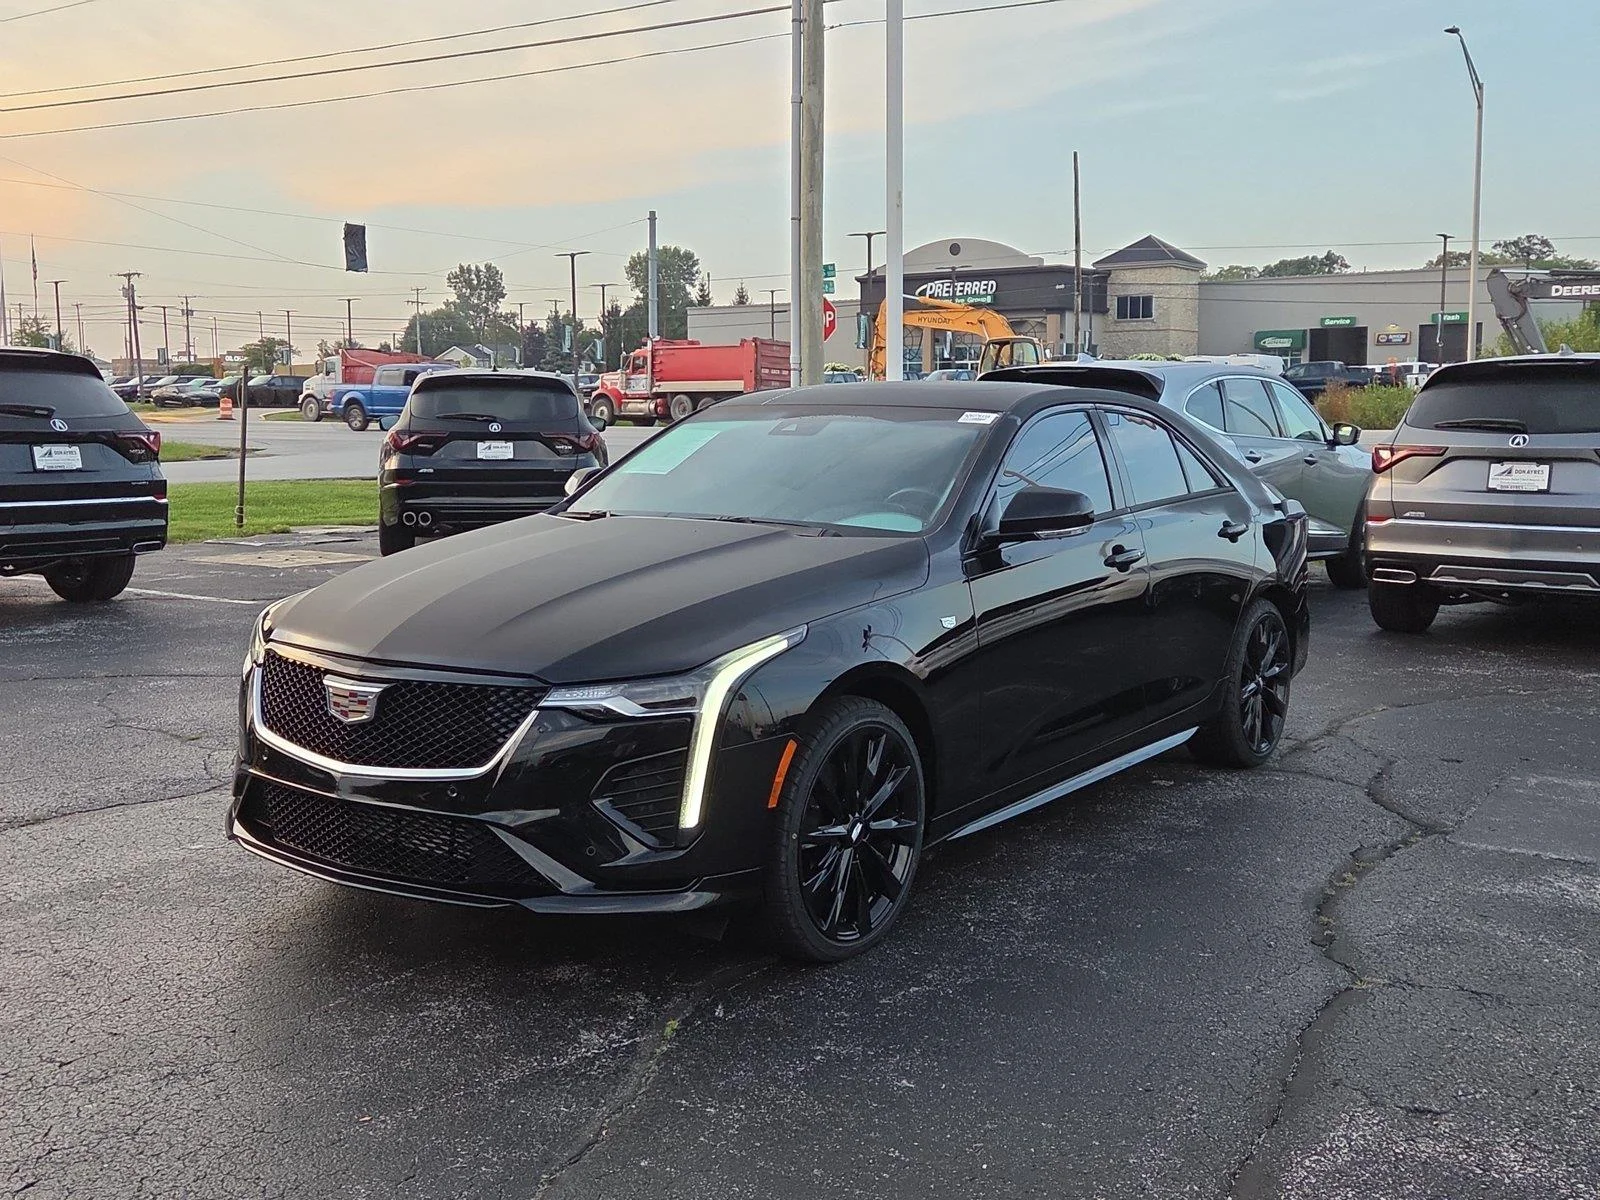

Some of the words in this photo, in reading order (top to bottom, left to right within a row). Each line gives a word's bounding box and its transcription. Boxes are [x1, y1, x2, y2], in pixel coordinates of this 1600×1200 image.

[926, 281, 997, 297] PREFERRED
[1551, 285, 1600, 296] DEERE
[917, 316, 951, 325] HYUNDAI
